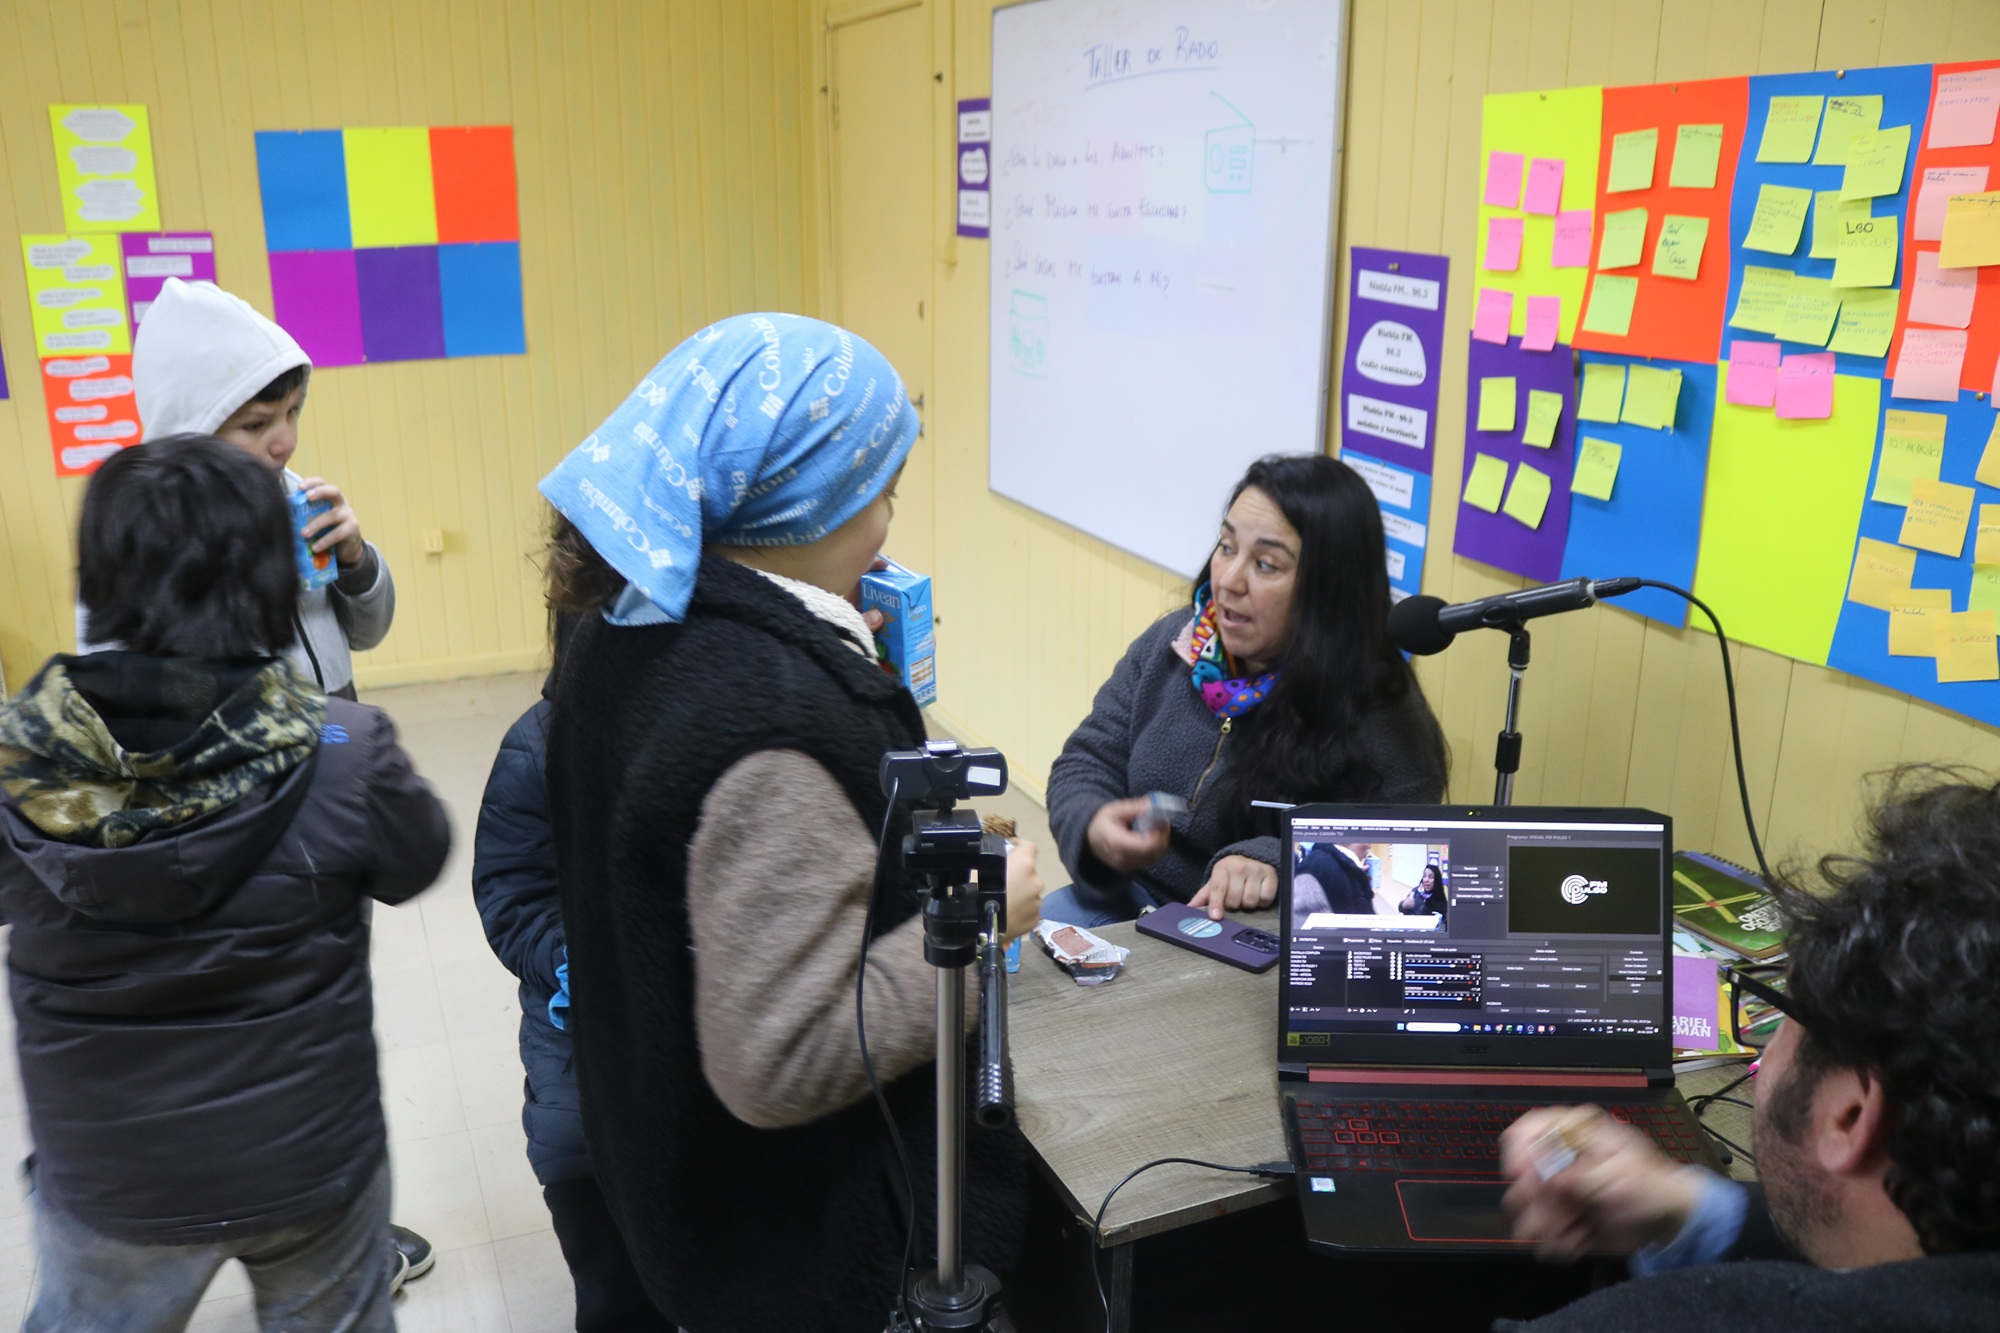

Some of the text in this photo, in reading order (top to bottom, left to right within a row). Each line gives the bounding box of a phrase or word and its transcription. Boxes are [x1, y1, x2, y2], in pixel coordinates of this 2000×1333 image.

[578, 477, 650, 553] Columbia
[863, 583, 902, 609] Livean
[1589, 880, 1608, 888] FM
